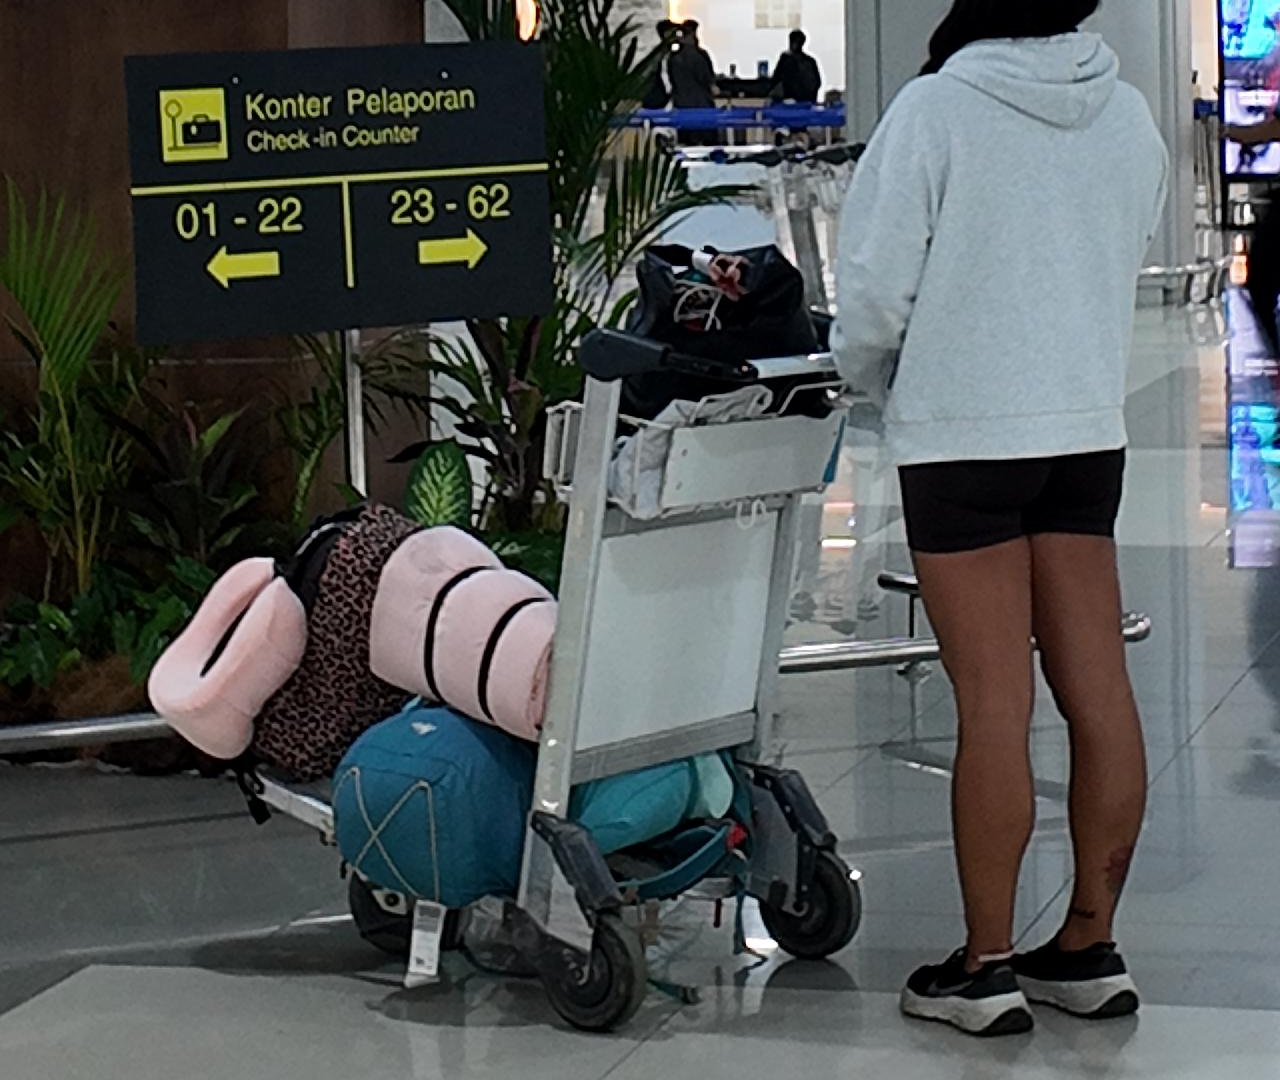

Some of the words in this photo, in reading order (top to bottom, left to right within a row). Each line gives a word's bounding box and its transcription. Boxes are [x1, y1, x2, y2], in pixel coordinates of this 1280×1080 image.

[246, 94, 331, 120] Konter
[348, 88, 474, 118] Pelaporan
[342, 126, 419, 146] Counter
[177, 203, 216, 238] 01
[259, 197, 302, 232] 22
[392, 188, 434, 223] 23
[468, 184, 510, 219] 62
